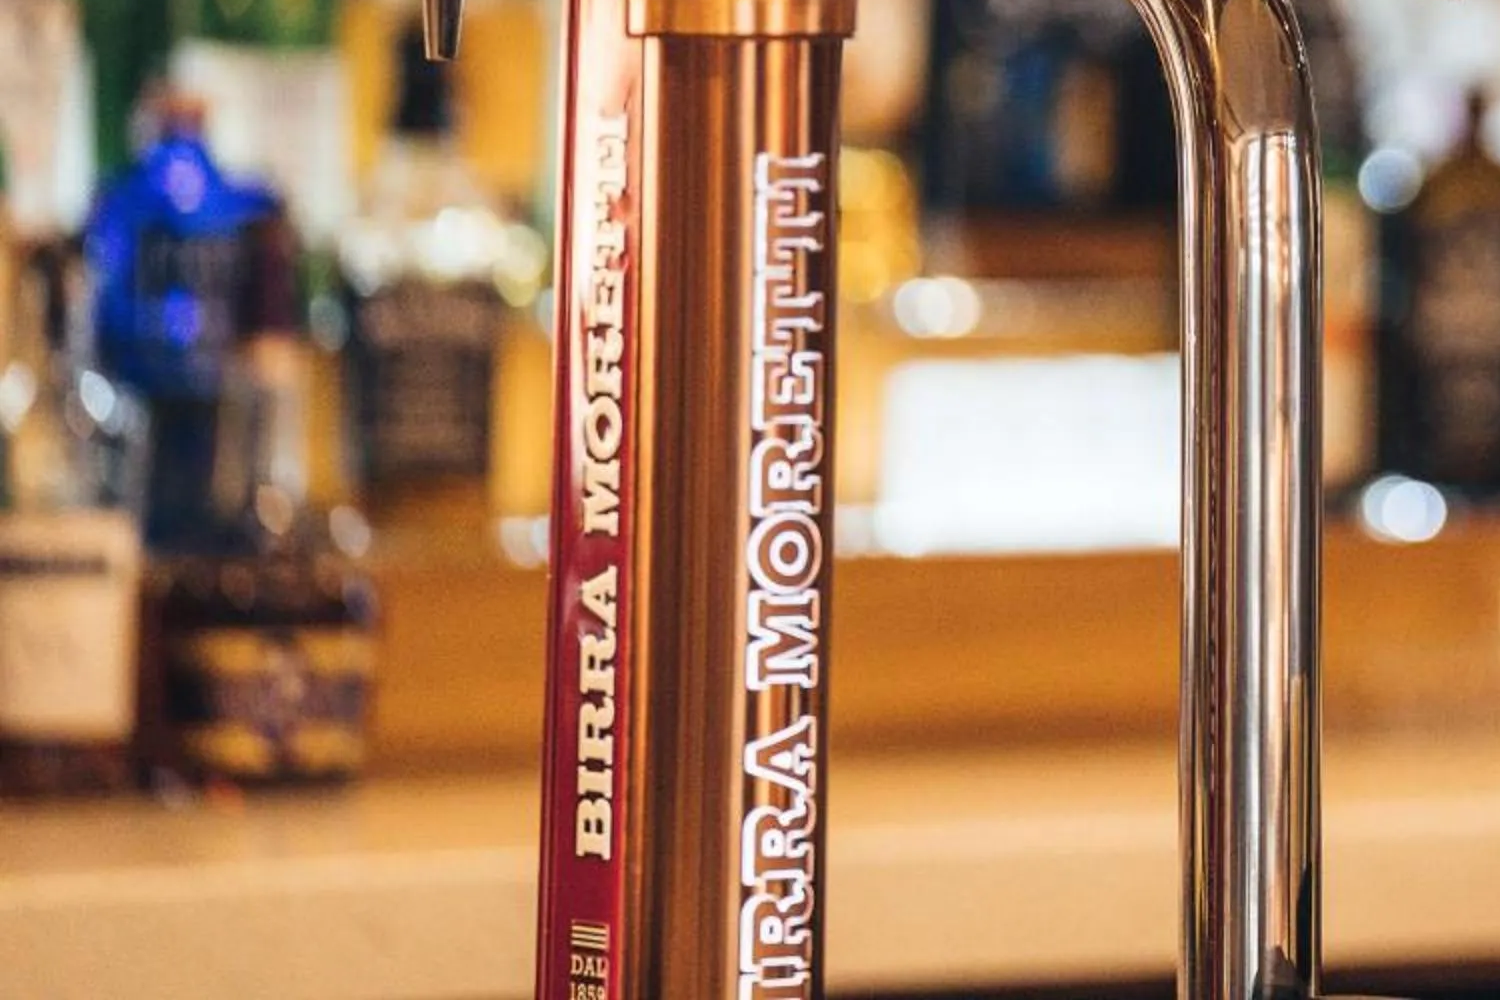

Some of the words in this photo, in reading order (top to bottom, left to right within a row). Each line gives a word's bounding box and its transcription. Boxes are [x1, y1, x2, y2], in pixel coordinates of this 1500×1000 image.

[580, 110, 628, 537] MORETTI
[747, 152, 825, 692] MORETTI
[576, 564, 619, 861] BIRRA
[739, 714, 818, 1000] IRRA
[570, 953, 609, 978] DAL
